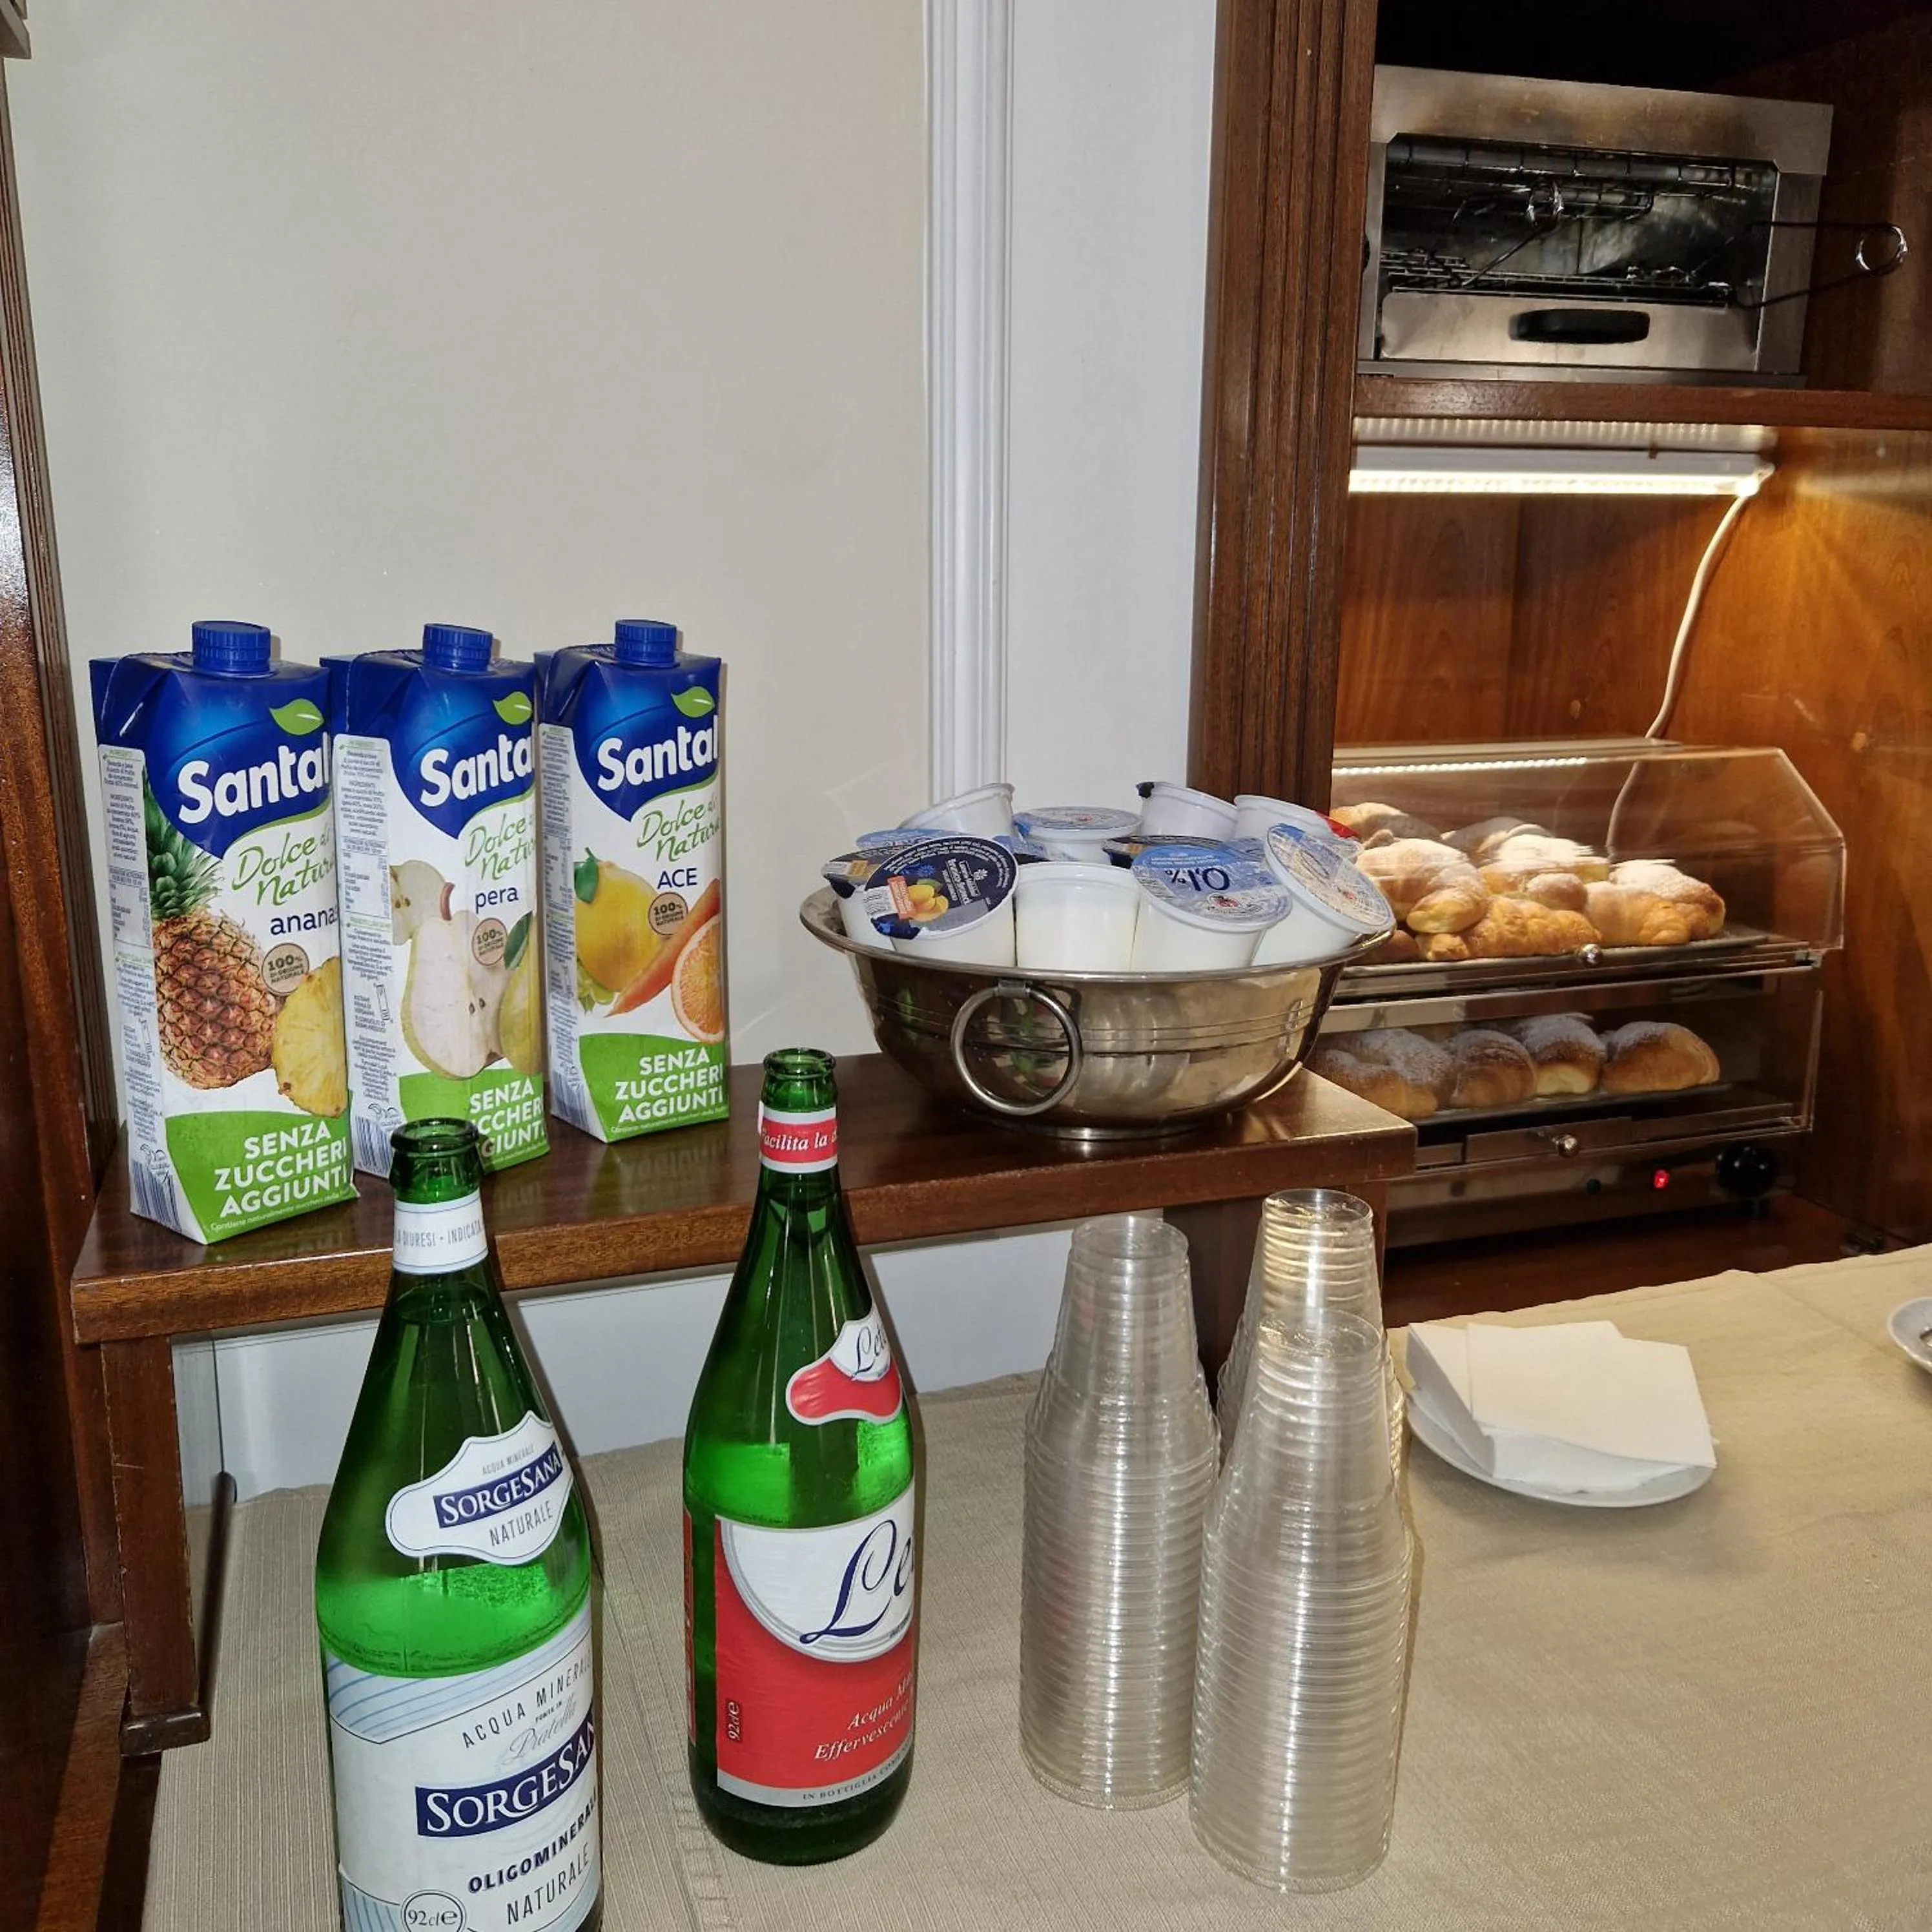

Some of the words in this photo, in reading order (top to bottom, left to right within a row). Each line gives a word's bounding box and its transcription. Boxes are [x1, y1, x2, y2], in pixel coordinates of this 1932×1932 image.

[597, 714, 718, 792] Santal
[178, 731, 329, 825] Santal
[465, 814, 525, 867] Dolce
[637, 799, 705, 848] Dolce
[232, 832, 316, 890] Dolce
[657, 867, 697, 889] ACE
[475, 887, 519, 914] pera
[615, 1062, 723, 1101] ZUCCHERI
[639, 1047, 710, 1075] SENZA
[470, 1076, 534, 1114] SENZA
[618, 1085, 723, 1123] AGGIUNTI
[244, 1120, 332, 1160] SENZA
[814, 1132, 827, 1149] la
[214, 1136, 347, 1192] ZUCCHERI
[219, 1163, 347, 1218] AGGIUNTI
[440, 1452, 561, 1524] SORGESANA
[489, 1500, 553, 1547] NATURALE
[799, 1519, 913, 1645] Le
[462, 1702, 526, 1749] ACQUA
[847, 1696, 894, 1731] Acqua
[507, 1842, 589, 1925] NATURALE
